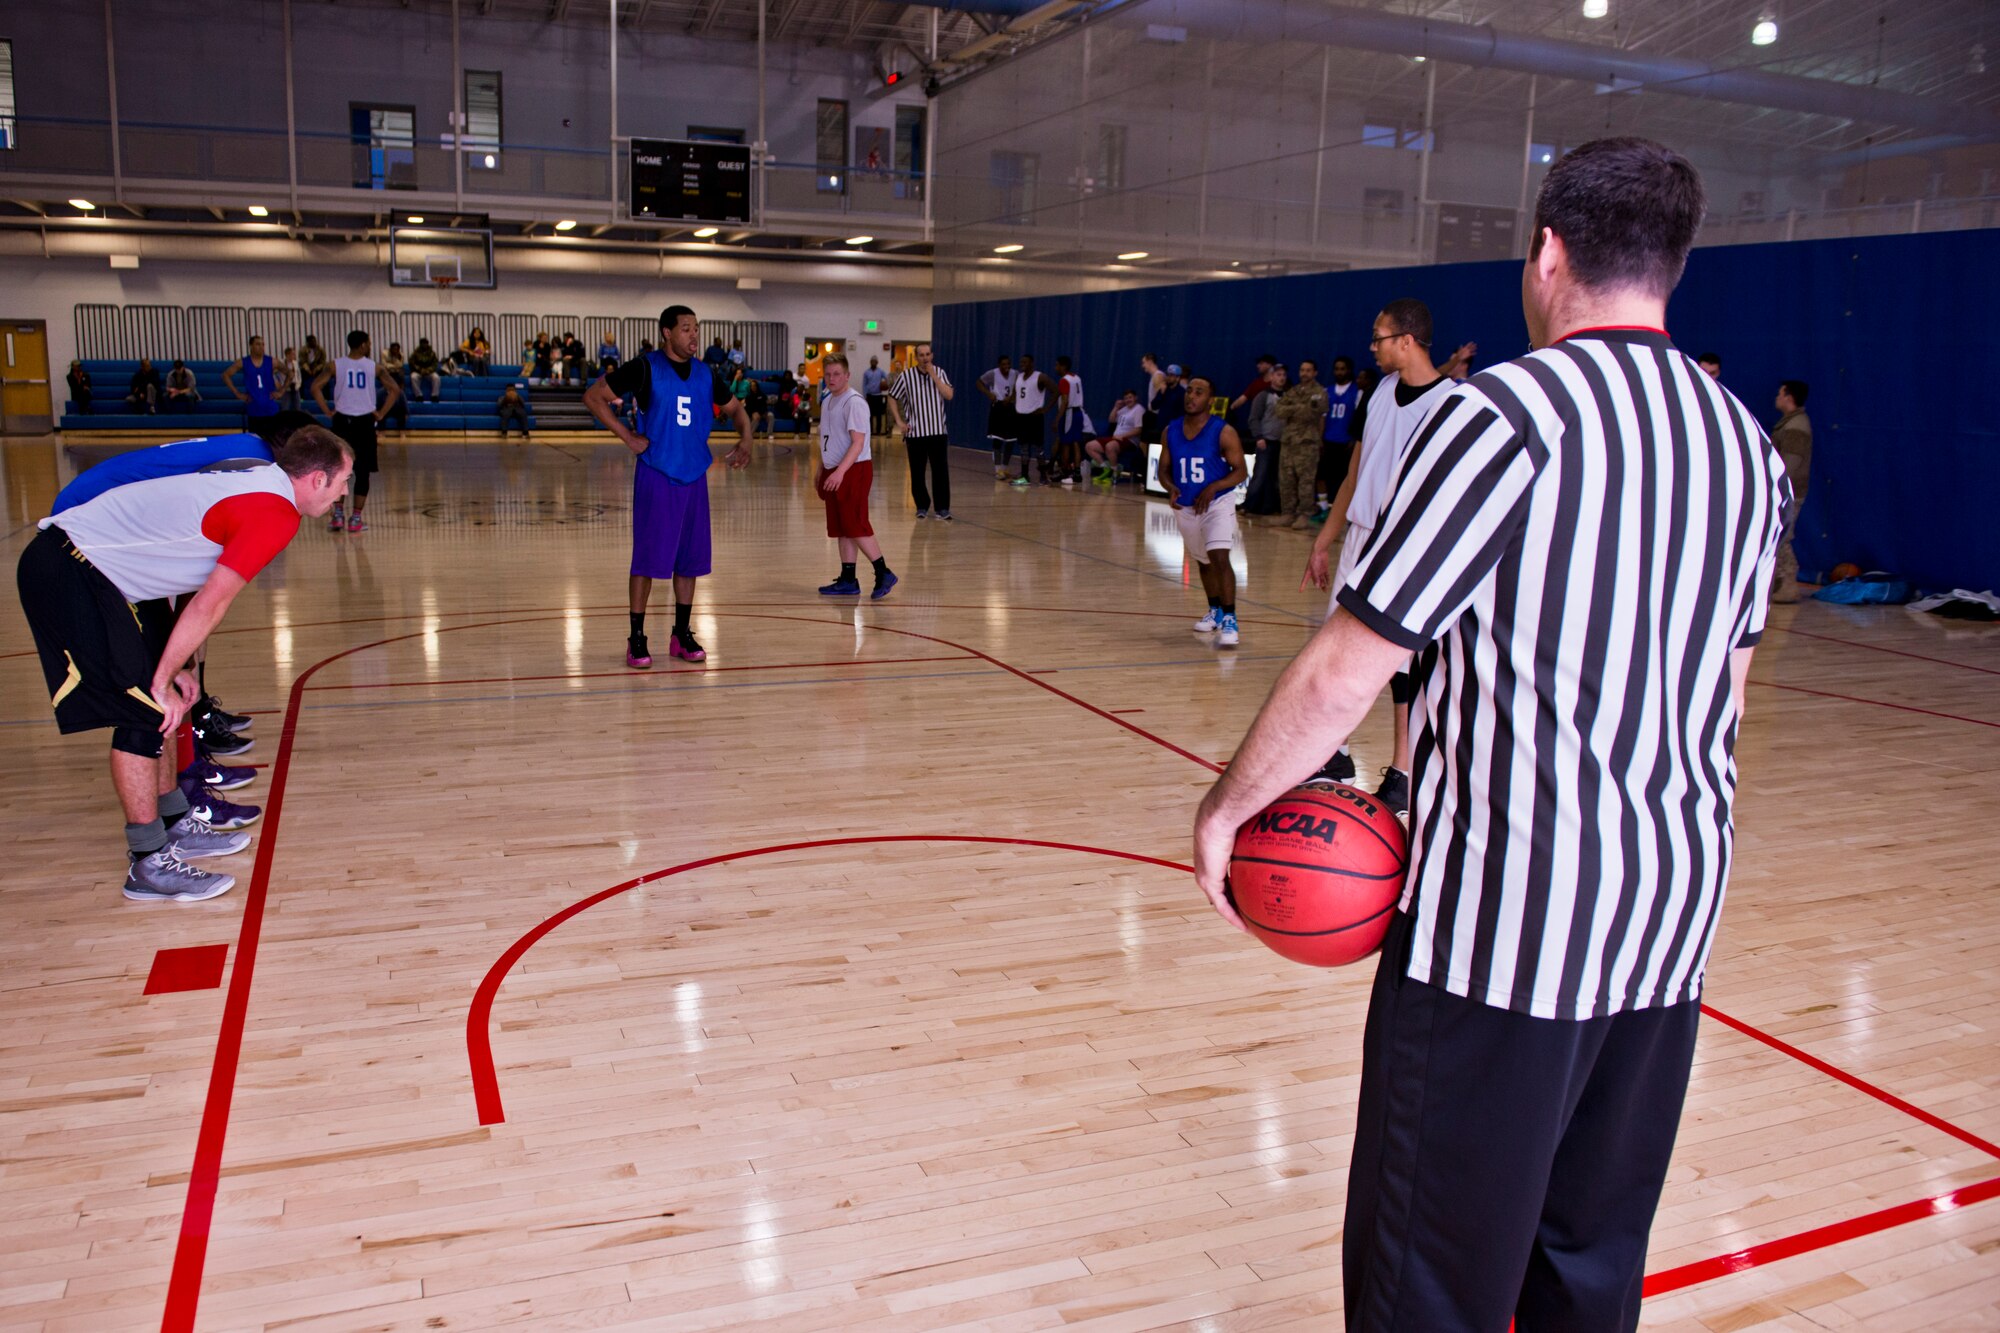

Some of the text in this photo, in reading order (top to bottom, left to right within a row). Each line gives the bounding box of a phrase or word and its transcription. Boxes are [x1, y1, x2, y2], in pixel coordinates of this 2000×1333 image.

[636, 155, 662, 166] HOME
[717, 161, 746, 171] GUEST
[257, 374, 263, 389] 1
[347, 371, 366, 389] 10
[1004, 386, 1010, 396] 3
[1020, 387, 1026, 399] 5
[677, 396, 691, 426] 5
[1331, 403, 1346, 419] 10
[823, 435, 830, 452] 7
[1179, 457, 1205, 483] 15
[1251, 812, 1338, 845] NCAA
[1305, 840, 1330, 852] BALL
